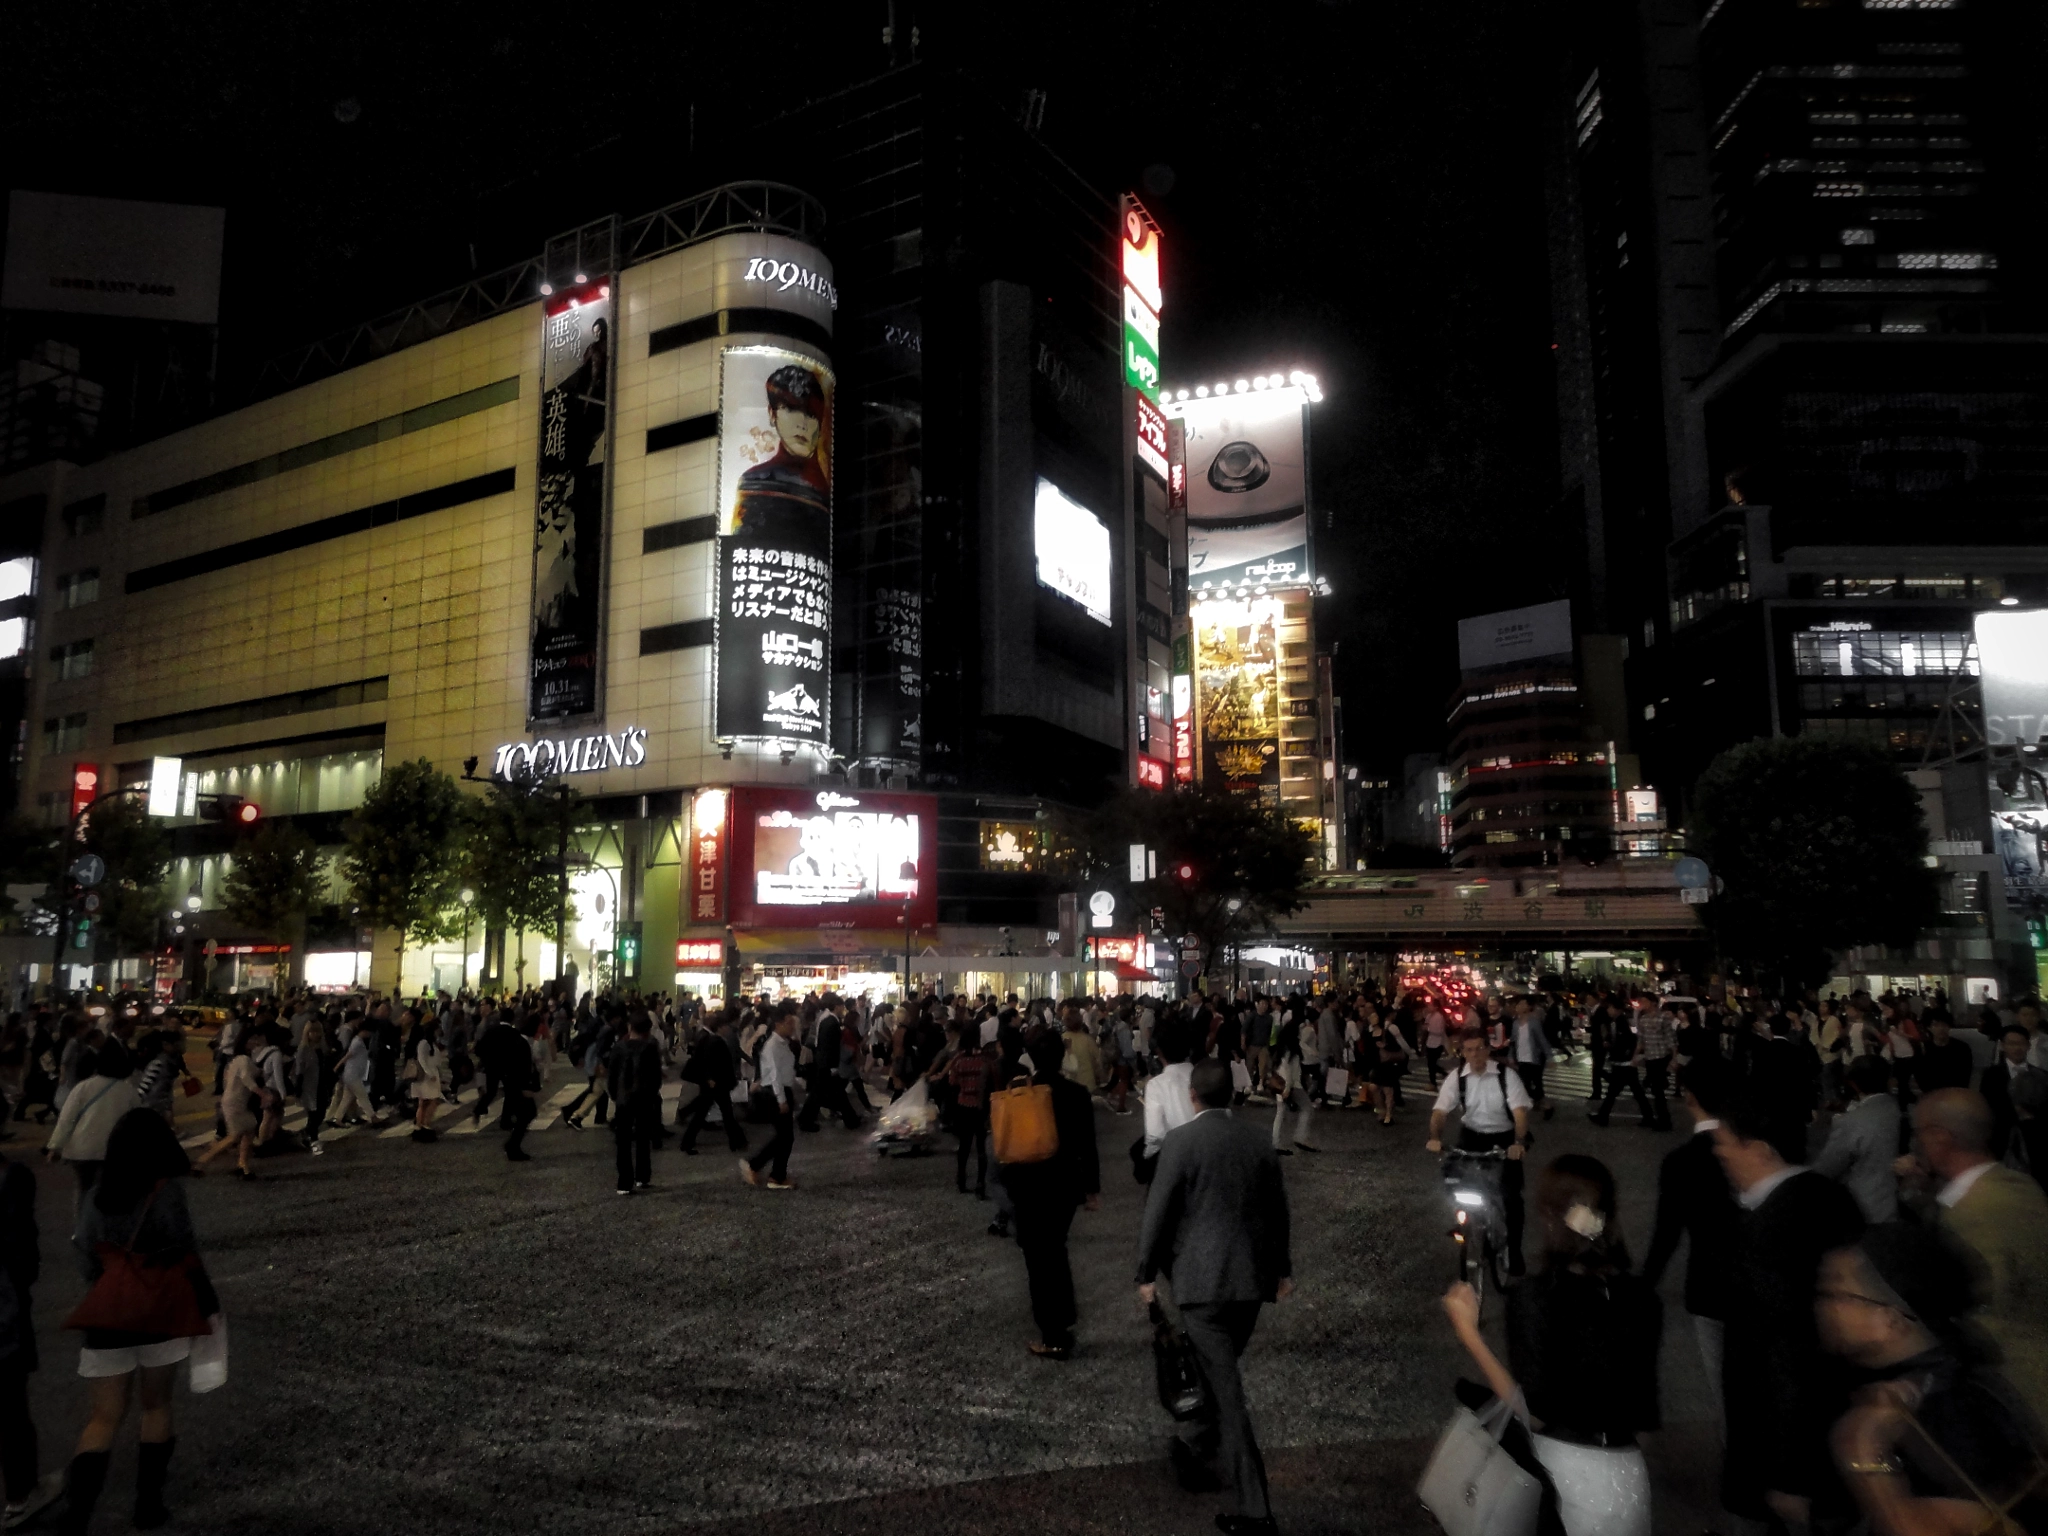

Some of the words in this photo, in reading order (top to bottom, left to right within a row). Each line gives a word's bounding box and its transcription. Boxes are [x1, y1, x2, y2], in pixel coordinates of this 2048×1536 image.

[1245, 558, 1296, 577] raycop
[544, 679, 570, 696] 10.31
[1403, 904, 1425, 919] JR
